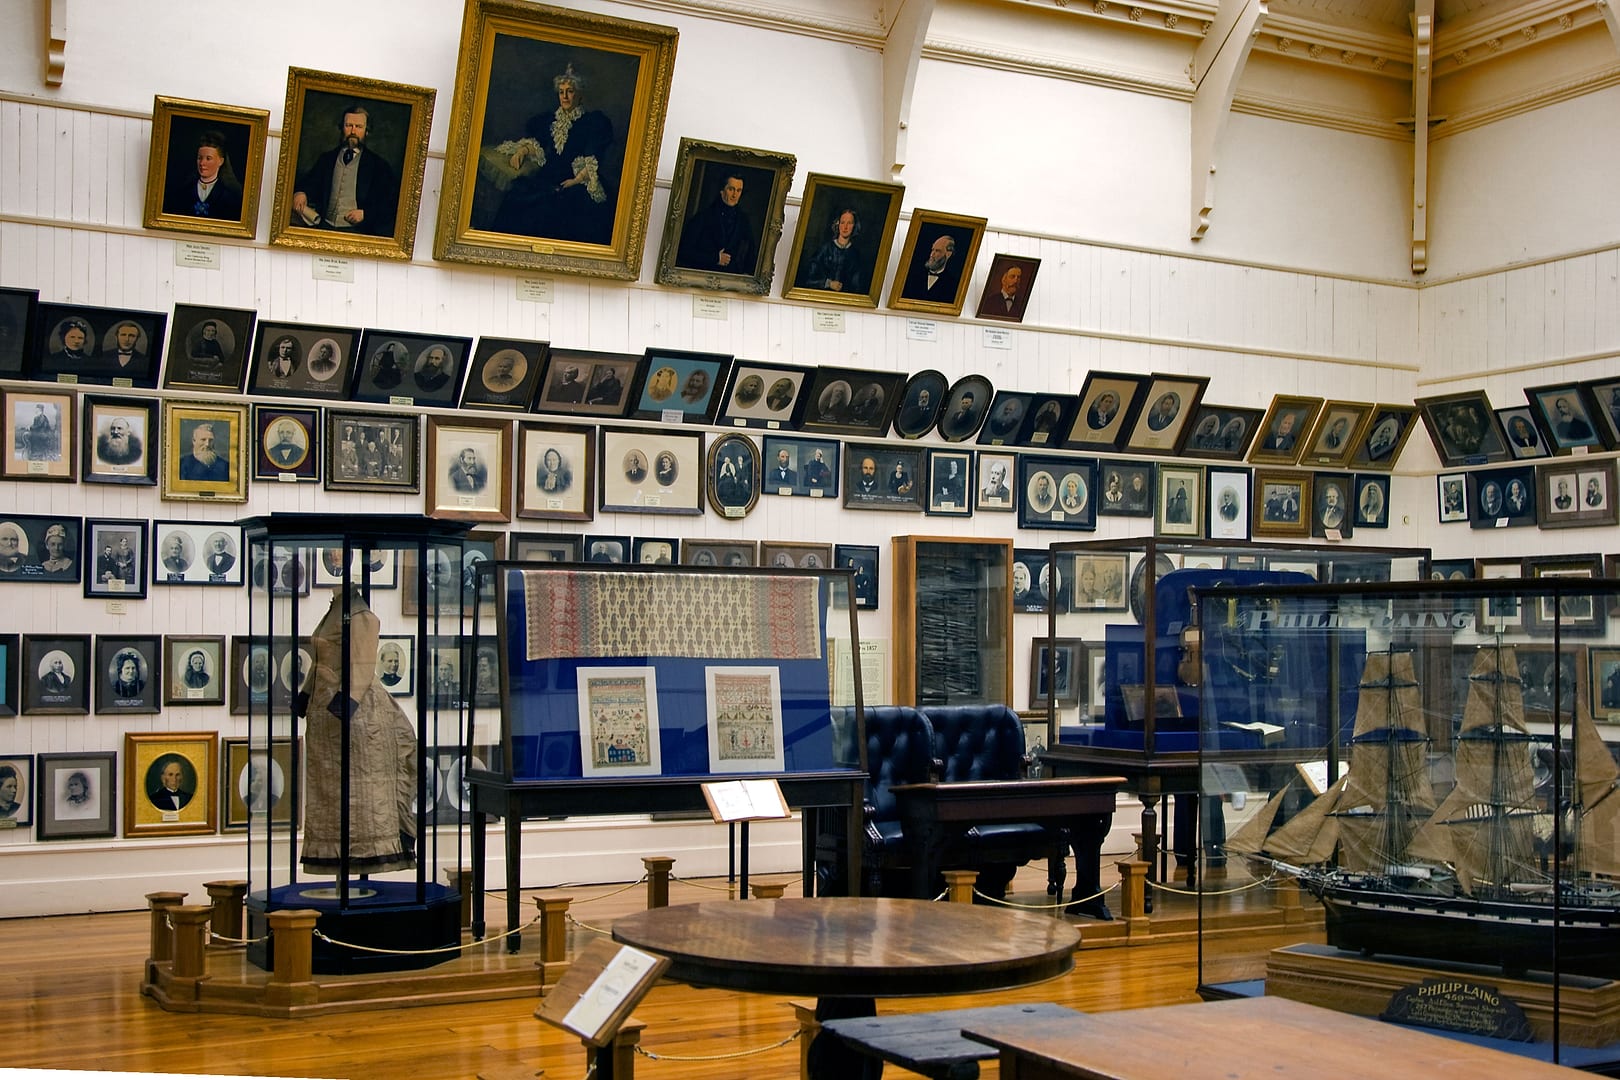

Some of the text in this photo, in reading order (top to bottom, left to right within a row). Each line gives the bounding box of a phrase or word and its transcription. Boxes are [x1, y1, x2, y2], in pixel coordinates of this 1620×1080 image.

[1370, 609, 1475, 629] LAING
[1418, 982, 1462, 996] PHILIP
[1463, 984, 1500, 1006] LAING
